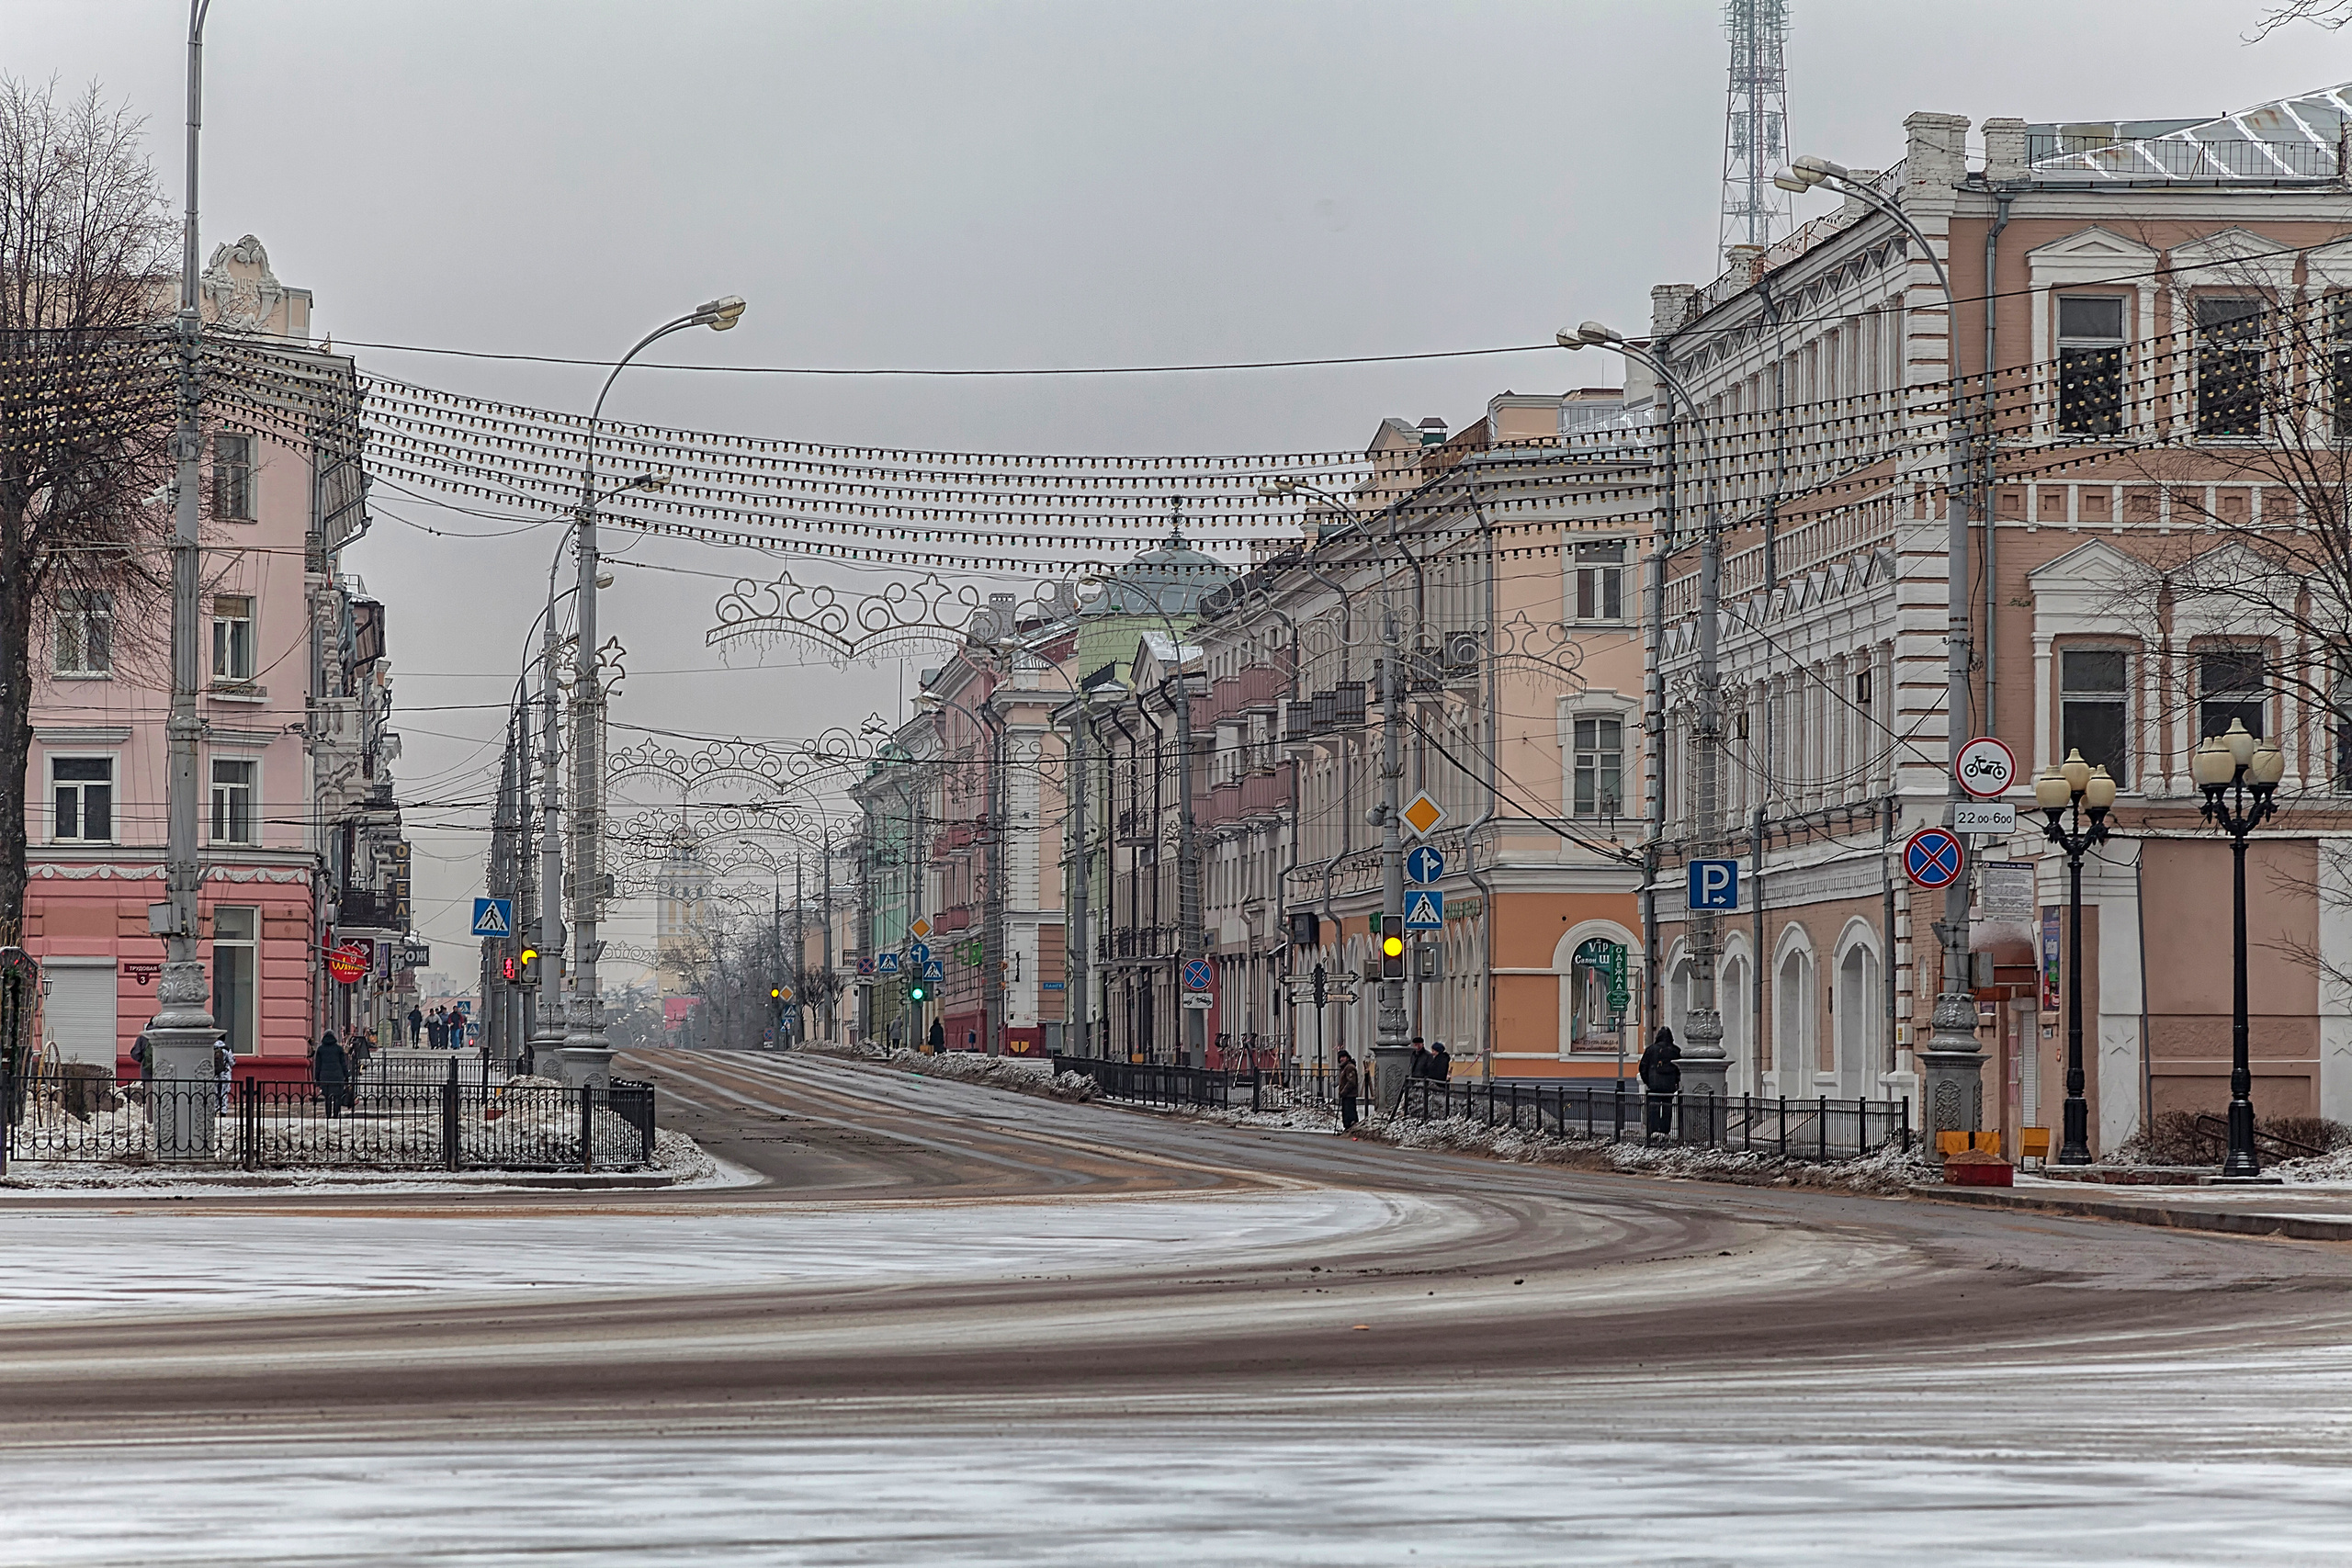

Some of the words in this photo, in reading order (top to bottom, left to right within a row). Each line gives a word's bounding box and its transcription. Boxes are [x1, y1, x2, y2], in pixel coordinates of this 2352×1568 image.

[1702, 864, 1730, 904] P
[140, 976, 146, 984] 3
[1614, 946, 1624, 990] ОДЕЖДА
